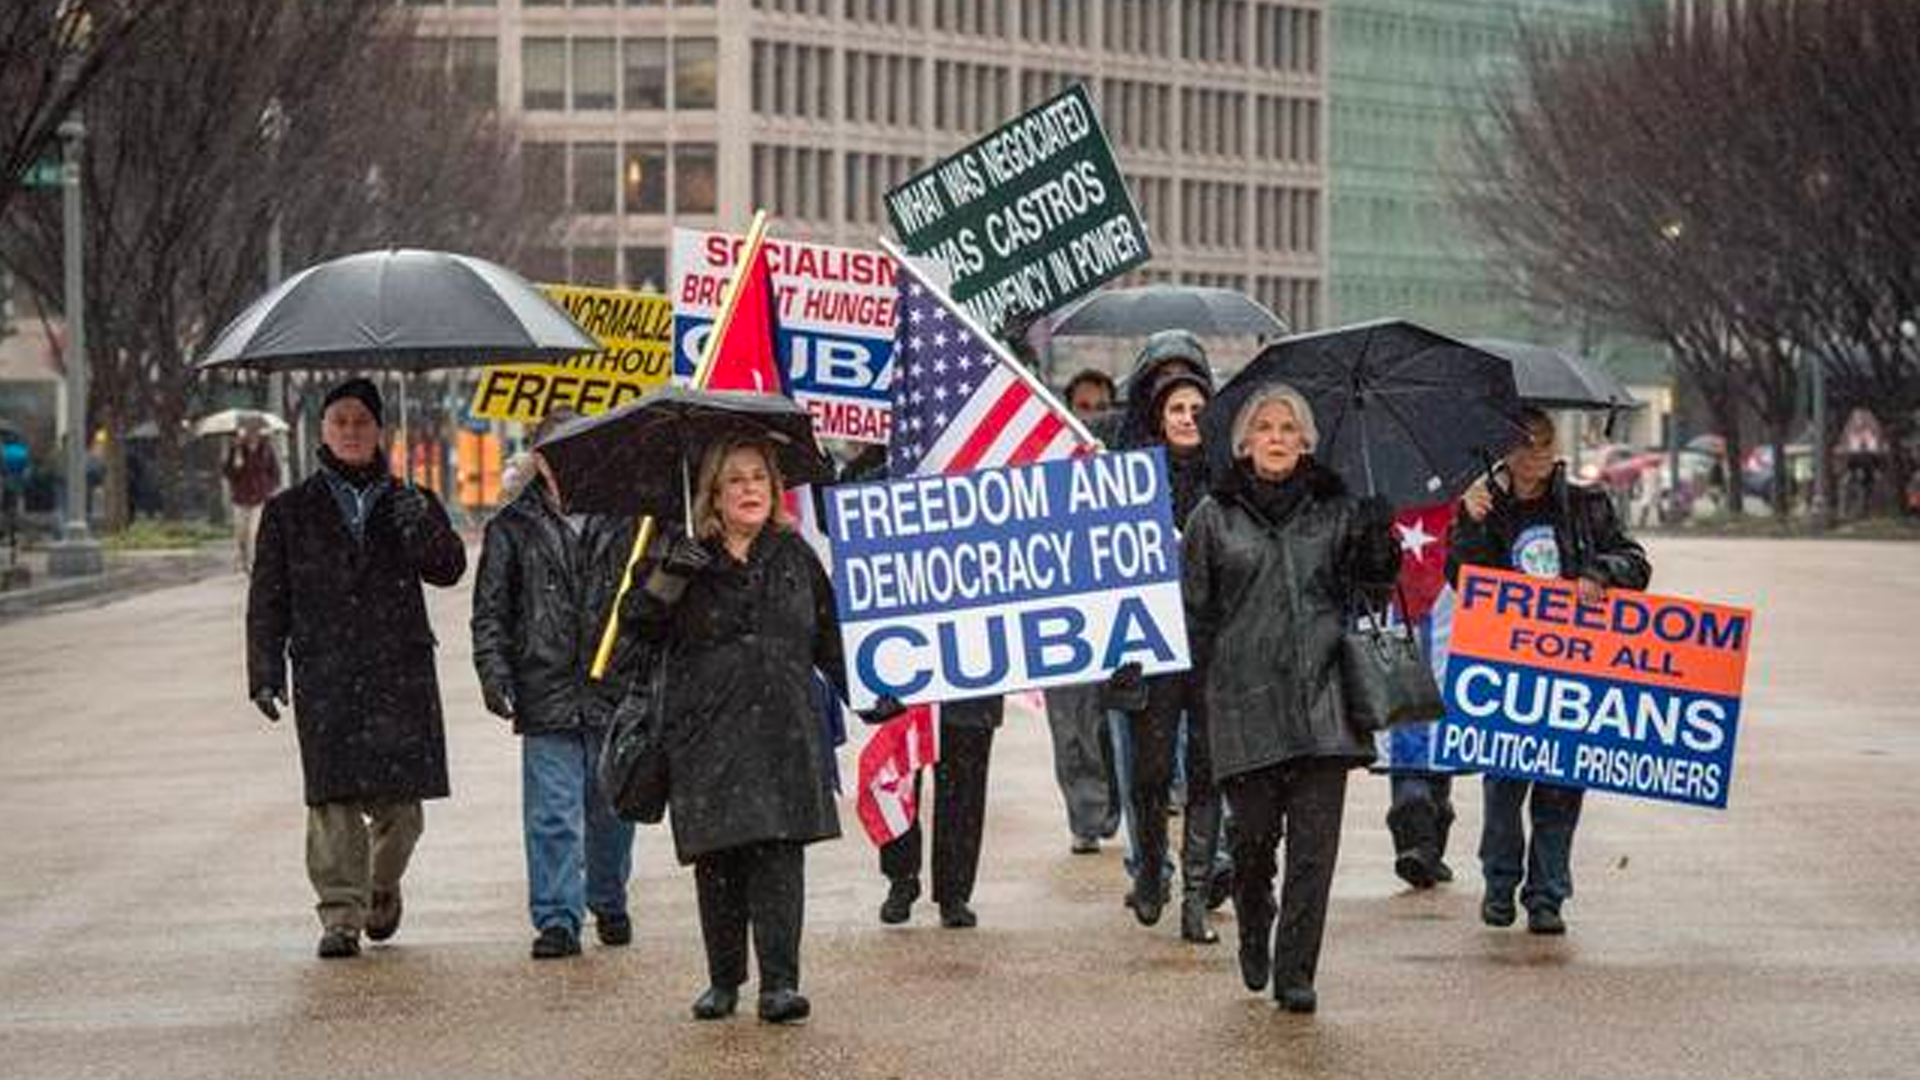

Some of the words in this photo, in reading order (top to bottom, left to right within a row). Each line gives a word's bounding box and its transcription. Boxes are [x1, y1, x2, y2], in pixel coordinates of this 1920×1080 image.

[890, 174, 945, 235] WHAT
[938, 152, 987, 208] WAS
[986, 160, 1106, 257] CASTRO'S
[1047, 248, 1078, 294] IN
[1070, 214, 1142, 282] POWER
[803, 288, 898, 328] HUNGE
[834, 467, 1050, 541] FREEDOM
[1069, 452, 1157, 514] AND
[845, 531, 1073, 611] DEMOCRACY
[1089, 521, 1166, 580] FOR
[856, 597, 1176, 698] CUBA
[1462, 576, 1746, 650] FREEDOM
[1510, 629, 1593, 662] FOR
[1612, 647, 1684, 677] ALL
[1454, 665, 1725, 751] CUBANS
[1443, 724, 1564, 776] POLITICAL
[1573, 745, 1721, 801] PRISIONERS
